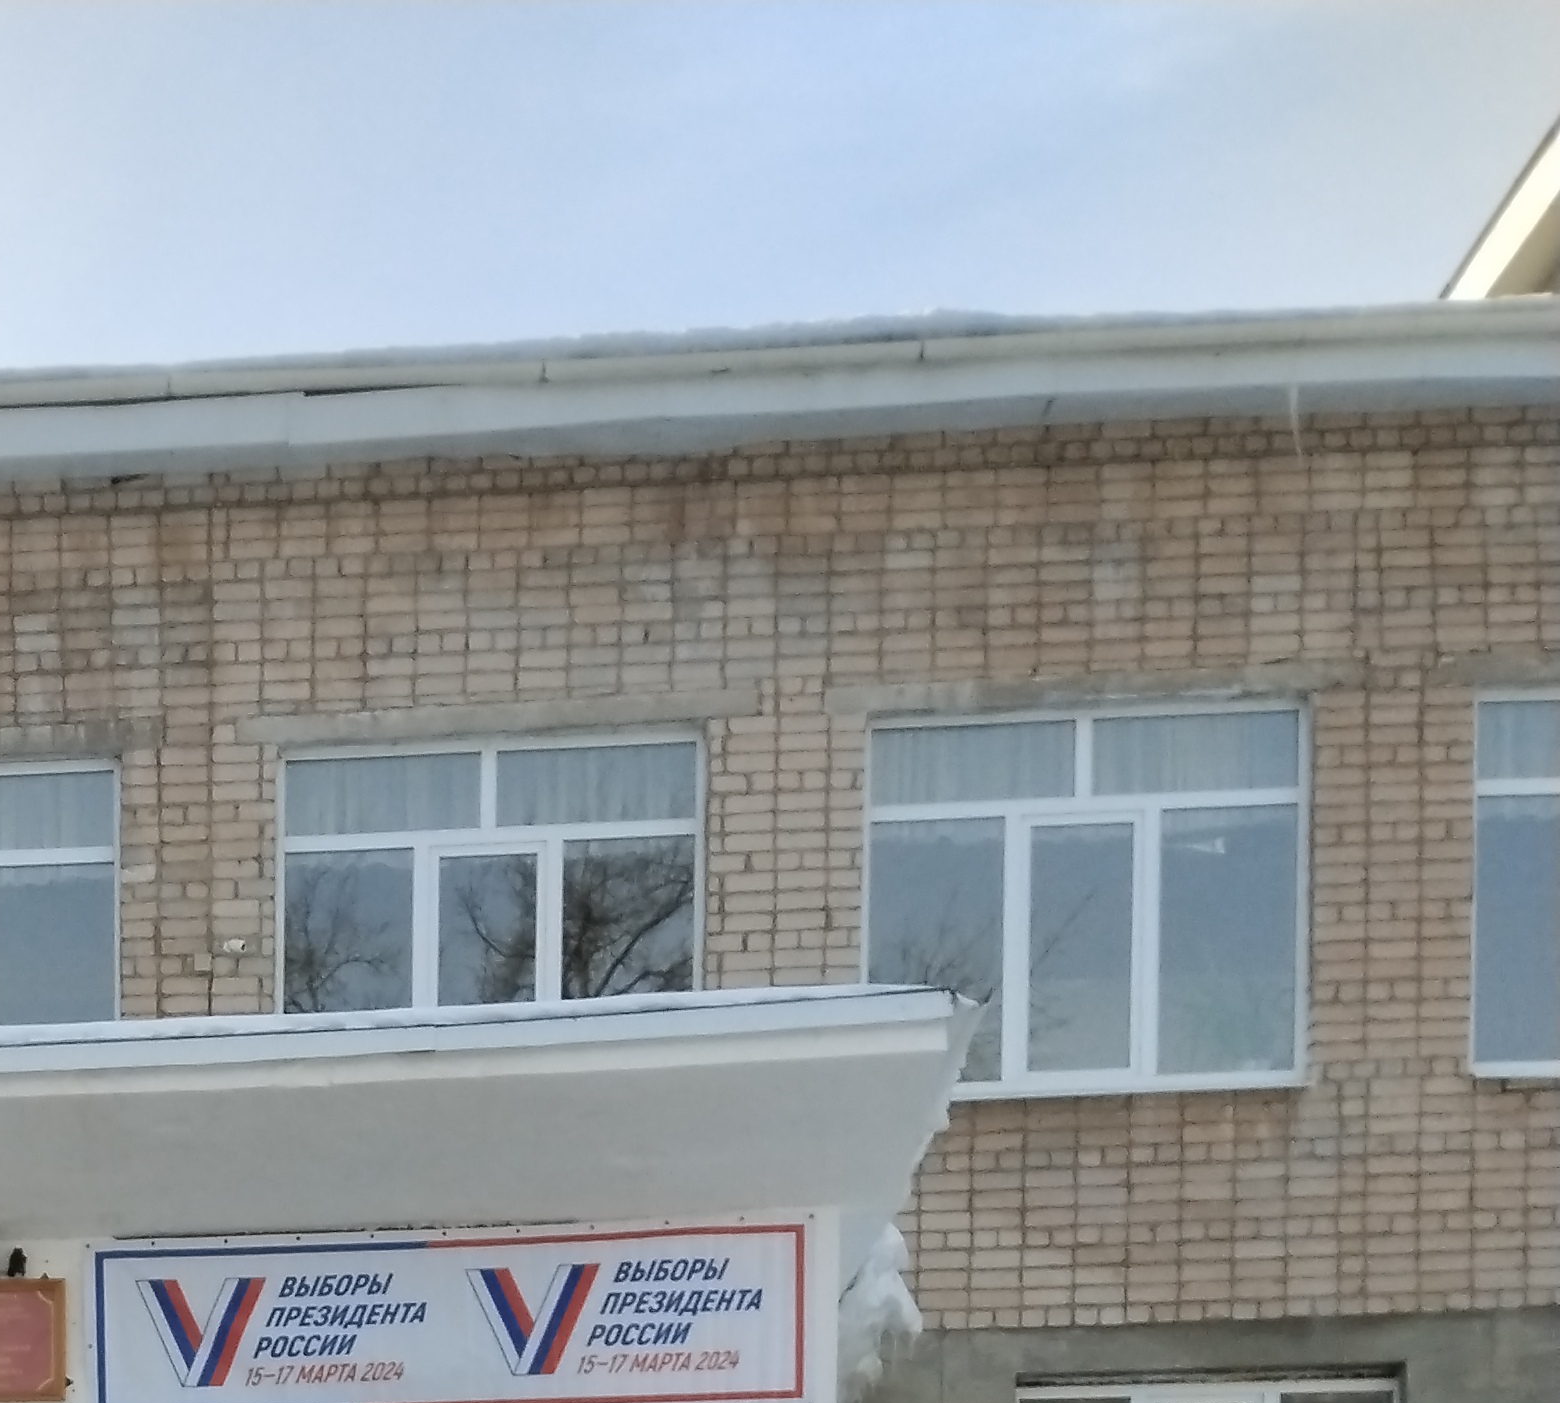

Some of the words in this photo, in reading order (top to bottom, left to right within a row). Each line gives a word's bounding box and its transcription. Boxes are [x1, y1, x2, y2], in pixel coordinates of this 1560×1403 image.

[613, 1257, 730, 1283] ВЫБОРЫ
[279, 1273, 393, 1298] ВЫБОРЫ
[600, 1287, 763, 1316] ПРЕЗИДЕНТА
[265, 1302, 428, 1329] ПРЕЗИДЕНТА
[253, 1333, 357, 1359] РОССИИ
[587, 1321, 694, 1347] РОССИИ
[295, 1362, 357, 1385] МАРТА
[360, 1361, 405, 1382] 2024
[629, 1352, 691, 1373] МАРТА
[694, 1350, 741, 1371] 2024
